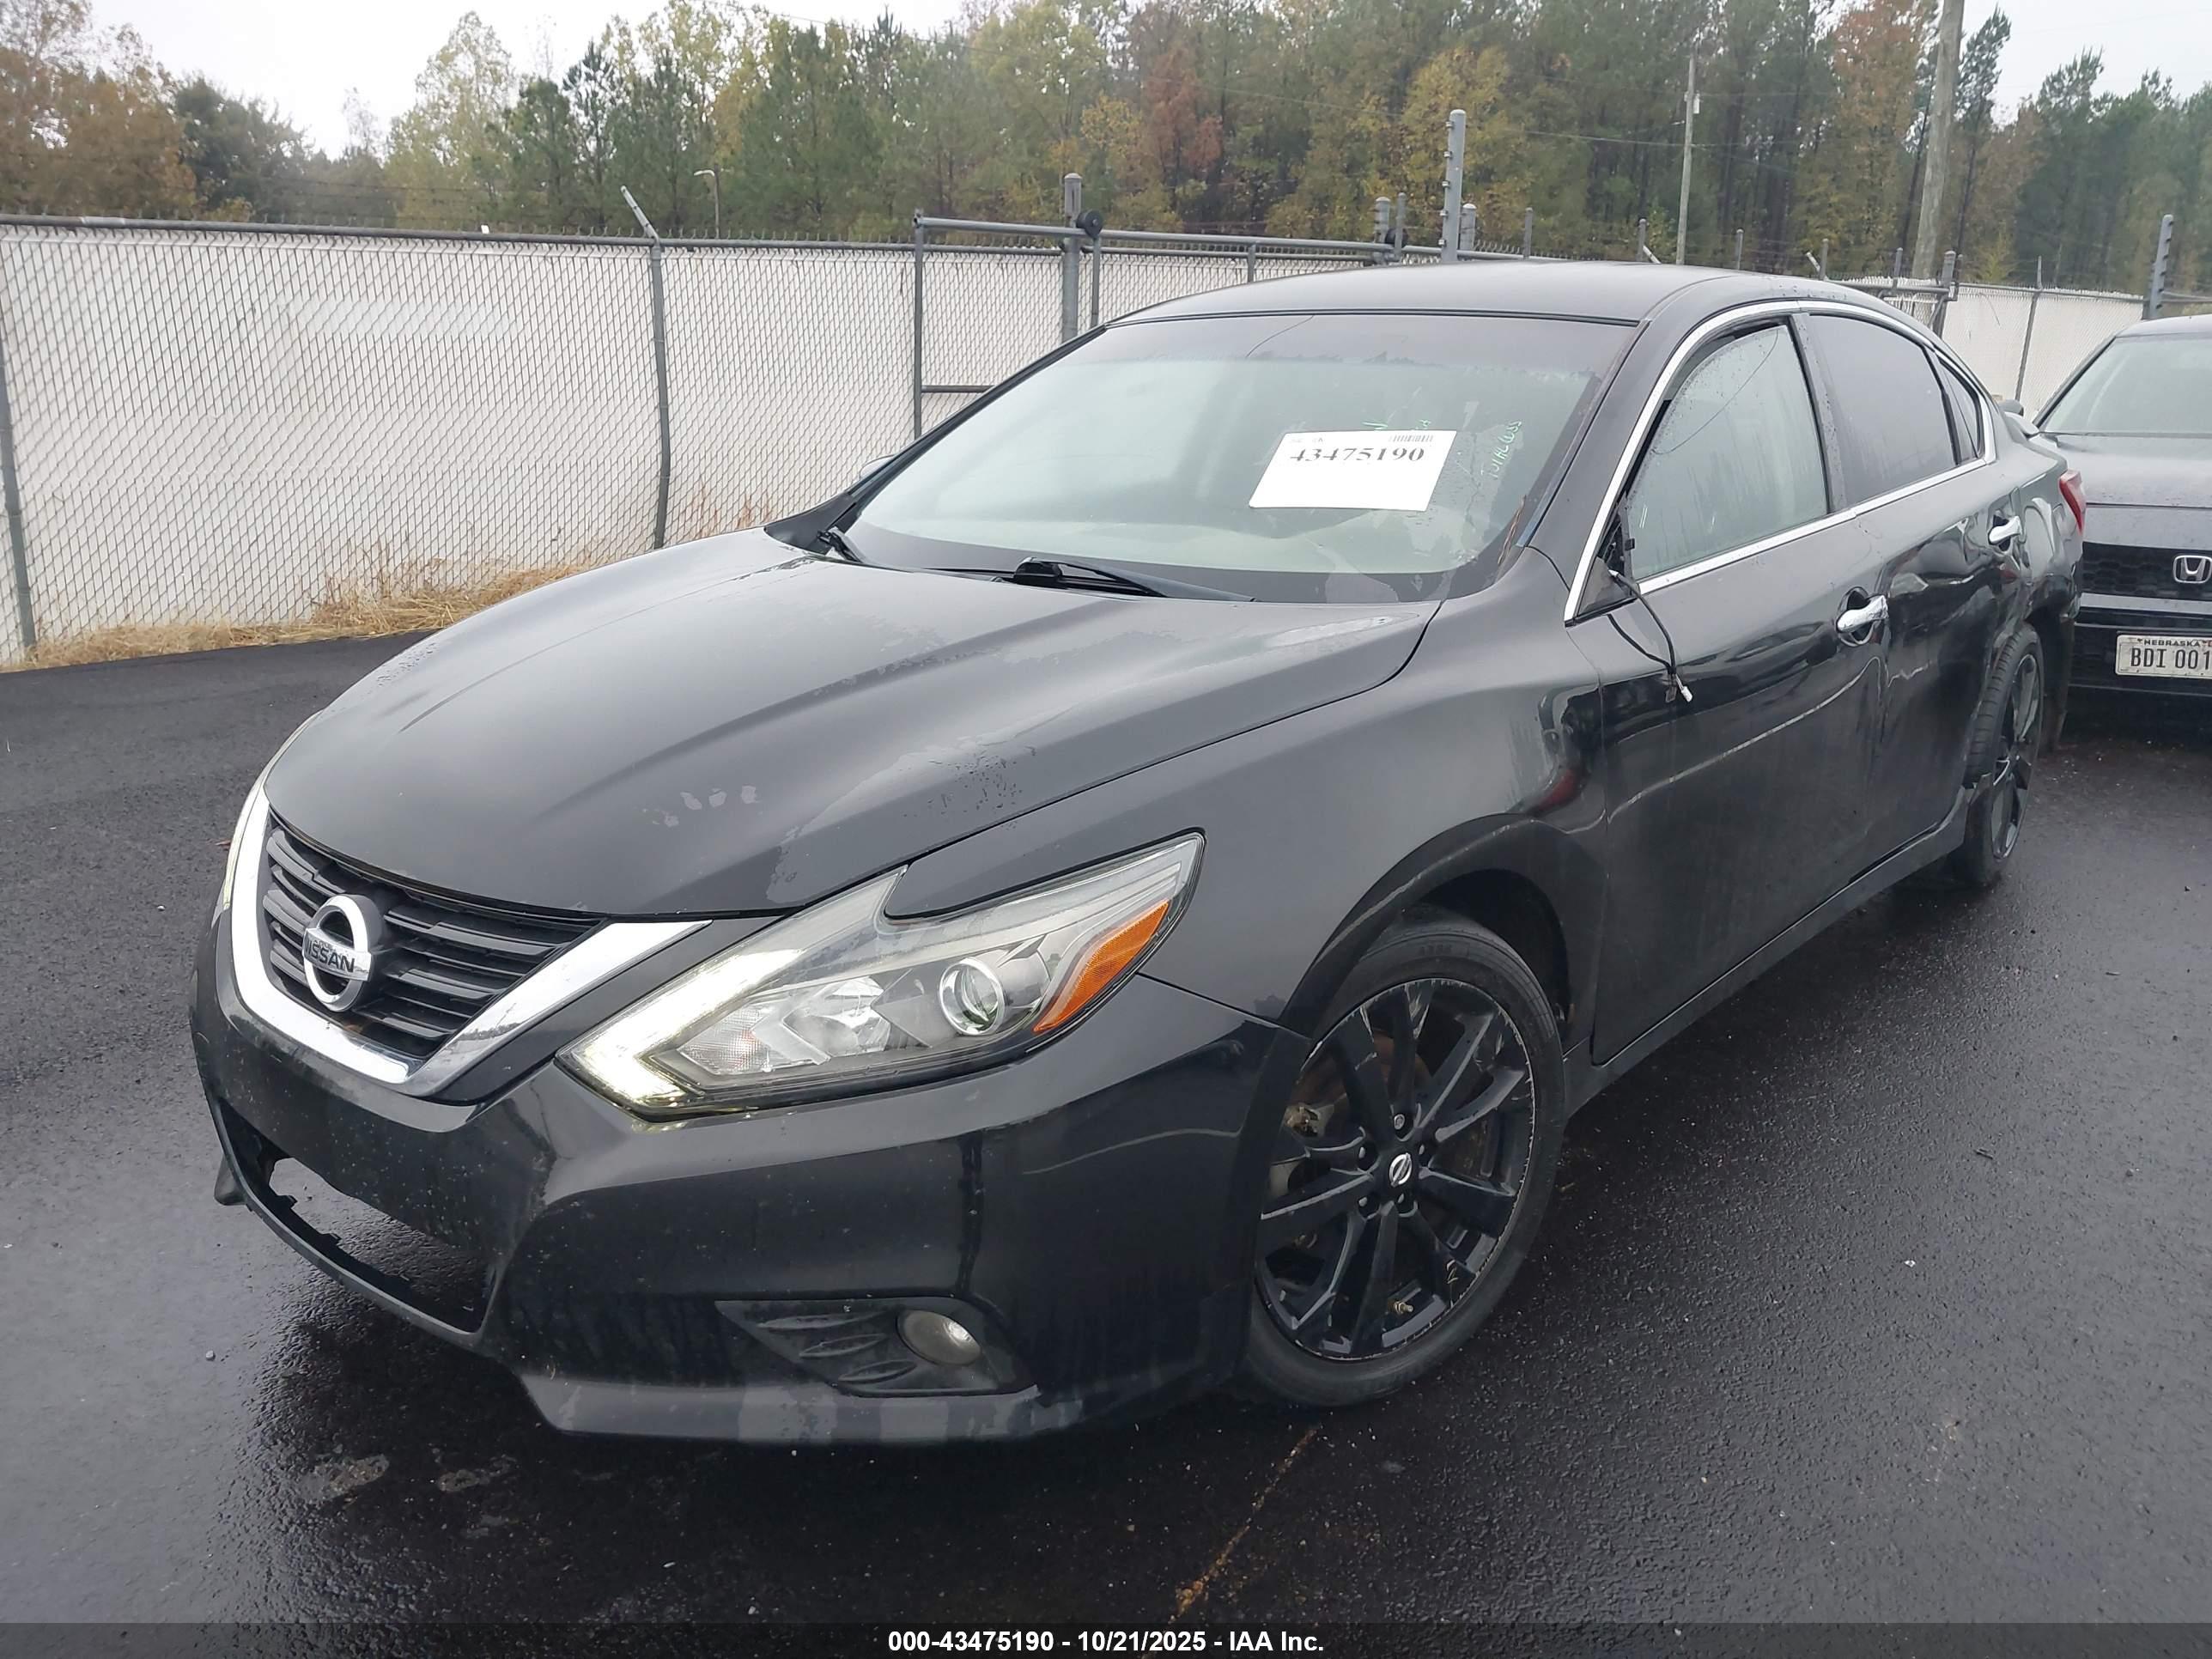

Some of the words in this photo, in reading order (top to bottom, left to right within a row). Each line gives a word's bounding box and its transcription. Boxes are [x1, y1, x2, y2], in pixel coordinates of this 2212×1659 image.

[1290, 447, 1425, 462] 43475190
[2143, 639, 2200, 647] NEBRASKA
[2130, 647, 2166, 668] BDI
[2175, 649, 2210, 670] 001
[304, 933, 356, 973] NISSAN
